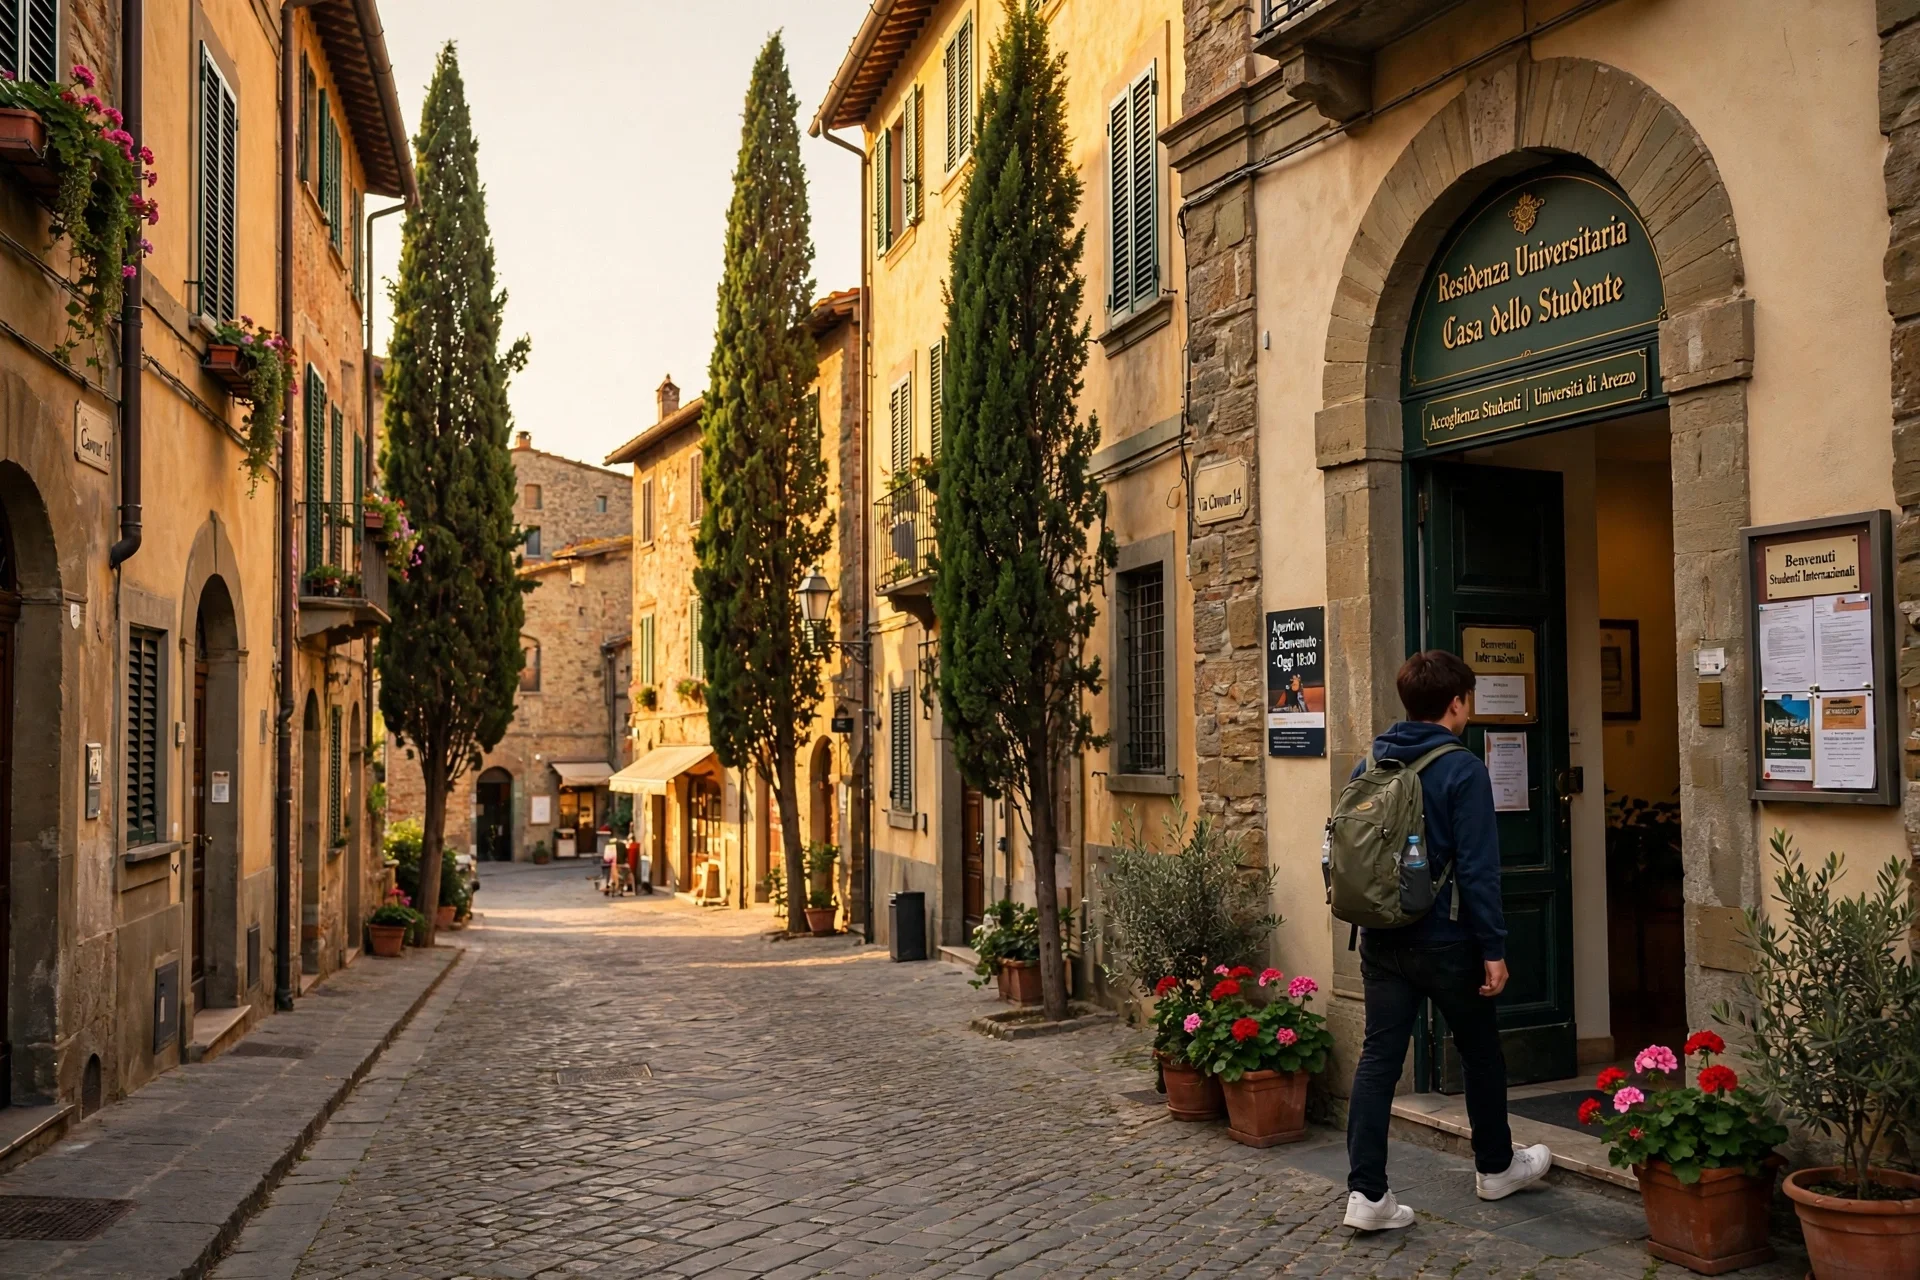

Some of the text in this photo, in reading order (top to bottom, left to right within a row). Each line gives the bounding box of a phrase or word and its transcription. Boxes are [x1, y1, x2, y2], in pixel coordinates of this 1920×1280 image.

[1438, 215, 1628, 303] Residenza Universitaria
[1443, 272, 1624, 349] Casa dello Studente
[1429, 407, 1480, 431] Accoglienza
[1482, 393, 1522, 419] Studenti
[1533, 378, 1584, 406] Università
[1586, 374, 1597, 393] di
[1600, 371, 1637, 391] Arezzo
[1785, 550, 1836, 568] Benvenuti
[1769, 570, 1801, 585] Studenti
[1271, 617, 1305, 636] Aperitivo
[1270, 636, 1278, 650] di
[1278, 636, 1317, 650] Benvenuto
[1480, 638, 1517, 650] Benvenuti
